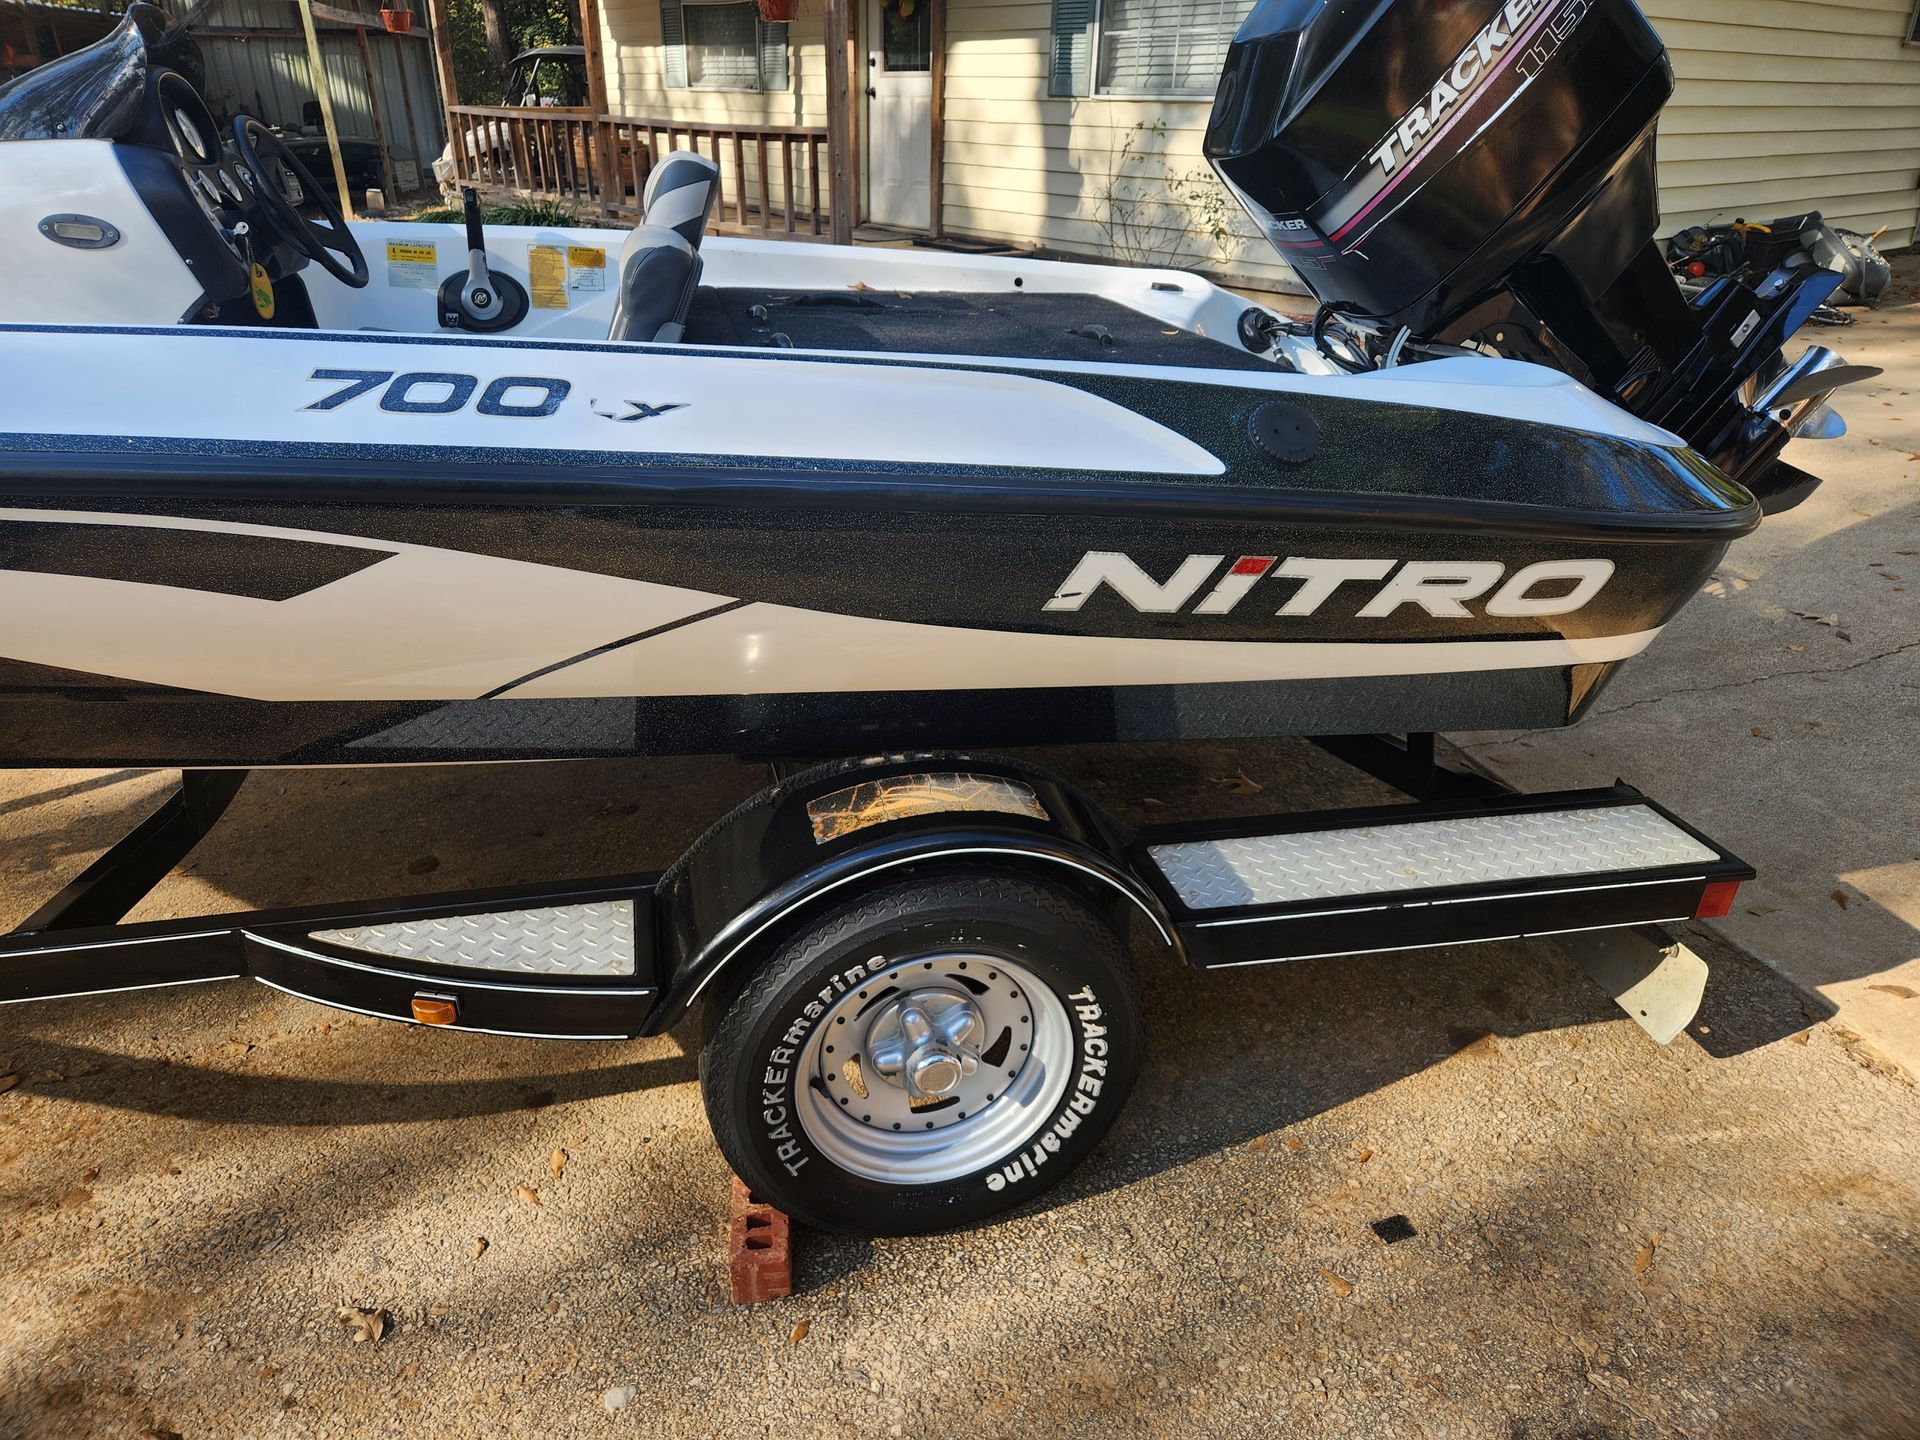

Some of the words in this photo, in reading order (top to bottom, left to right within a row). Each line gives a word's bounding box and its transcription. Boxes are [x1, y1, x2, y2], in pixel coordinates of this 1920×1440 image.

[1369, 0, 1541, 174] TRACKE
[1421, 119, 1455, 158] MERCURY
[296, 367, 575, 419] 700
